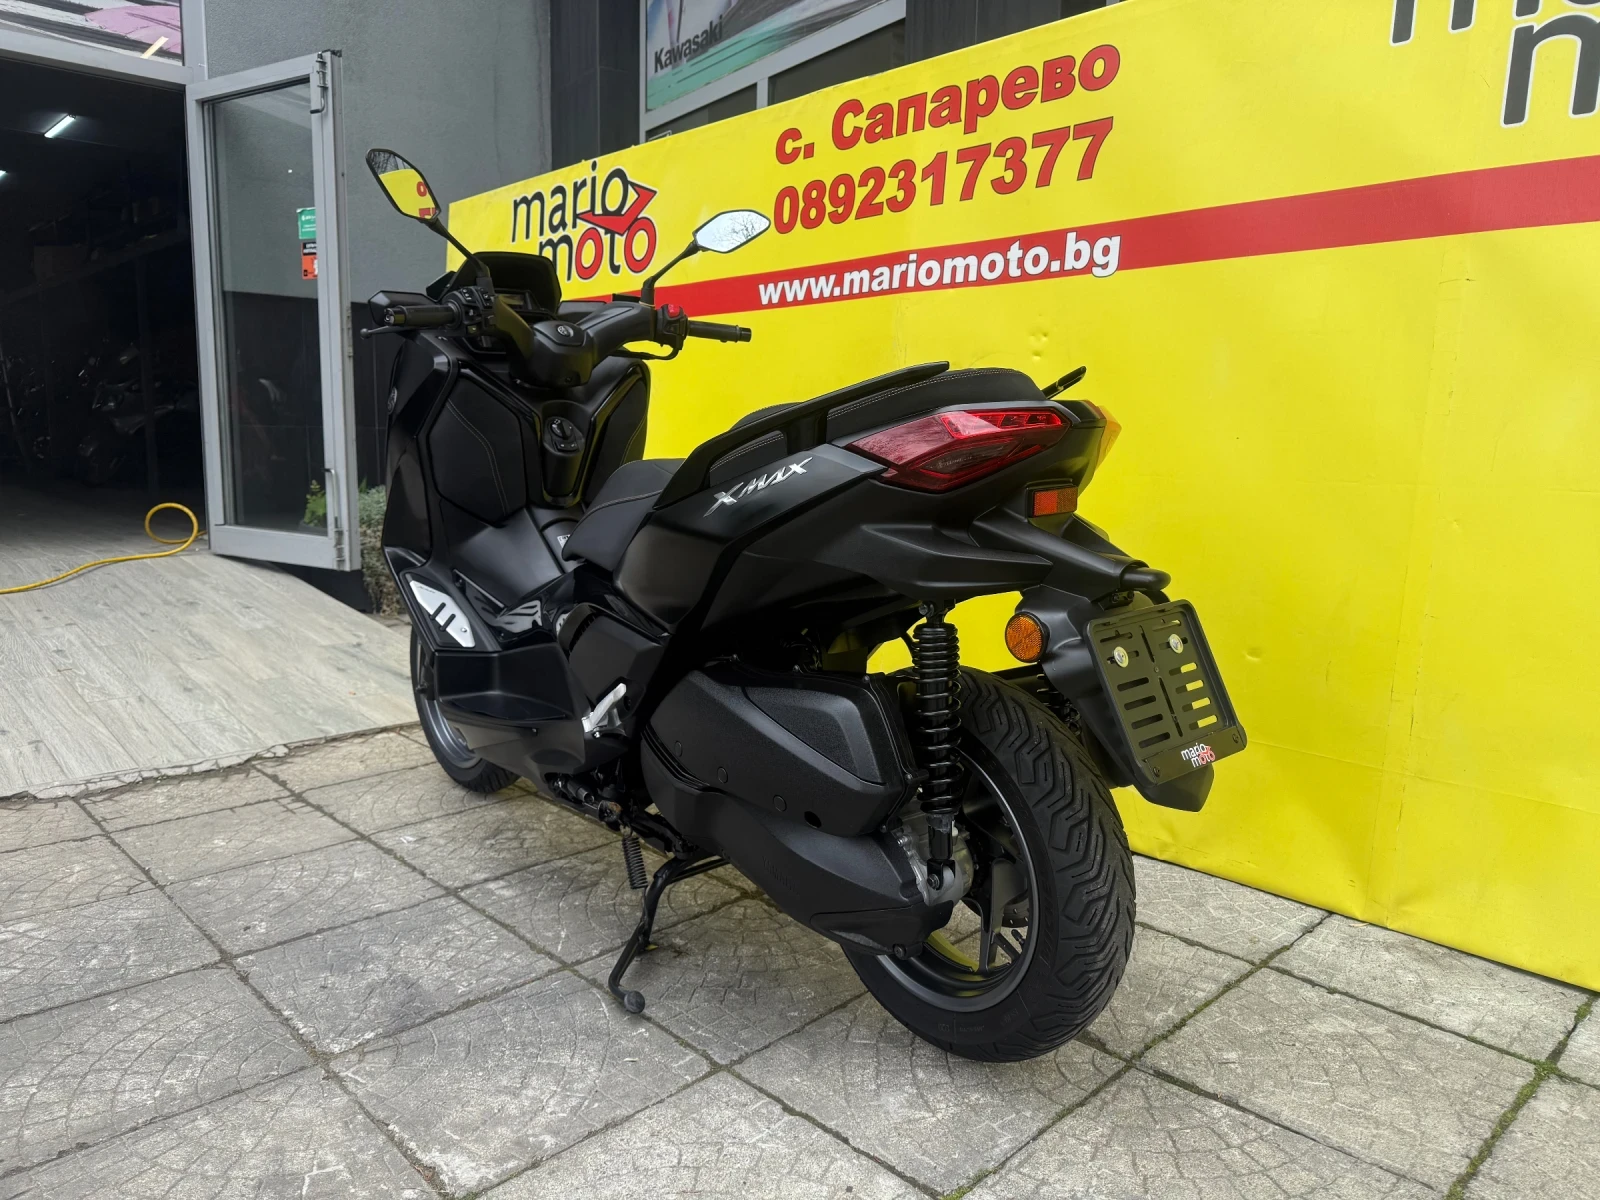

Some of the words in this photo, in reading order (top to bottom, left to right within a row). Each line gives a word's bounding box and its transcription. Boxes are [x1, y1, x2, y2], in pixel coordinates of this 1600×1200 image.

[654, 14, 723, 74] Kawasaki
[831, 44, 1121, 151] Сапарево
[511, 160, 630, 243] mario
[773, 116, 1113, 235] 0892317377
[539, 216, 657, 282] moto
[758, 231, 1122, 306] www.mariomoto.bg
[1181, 743, 1206, 760] mario
